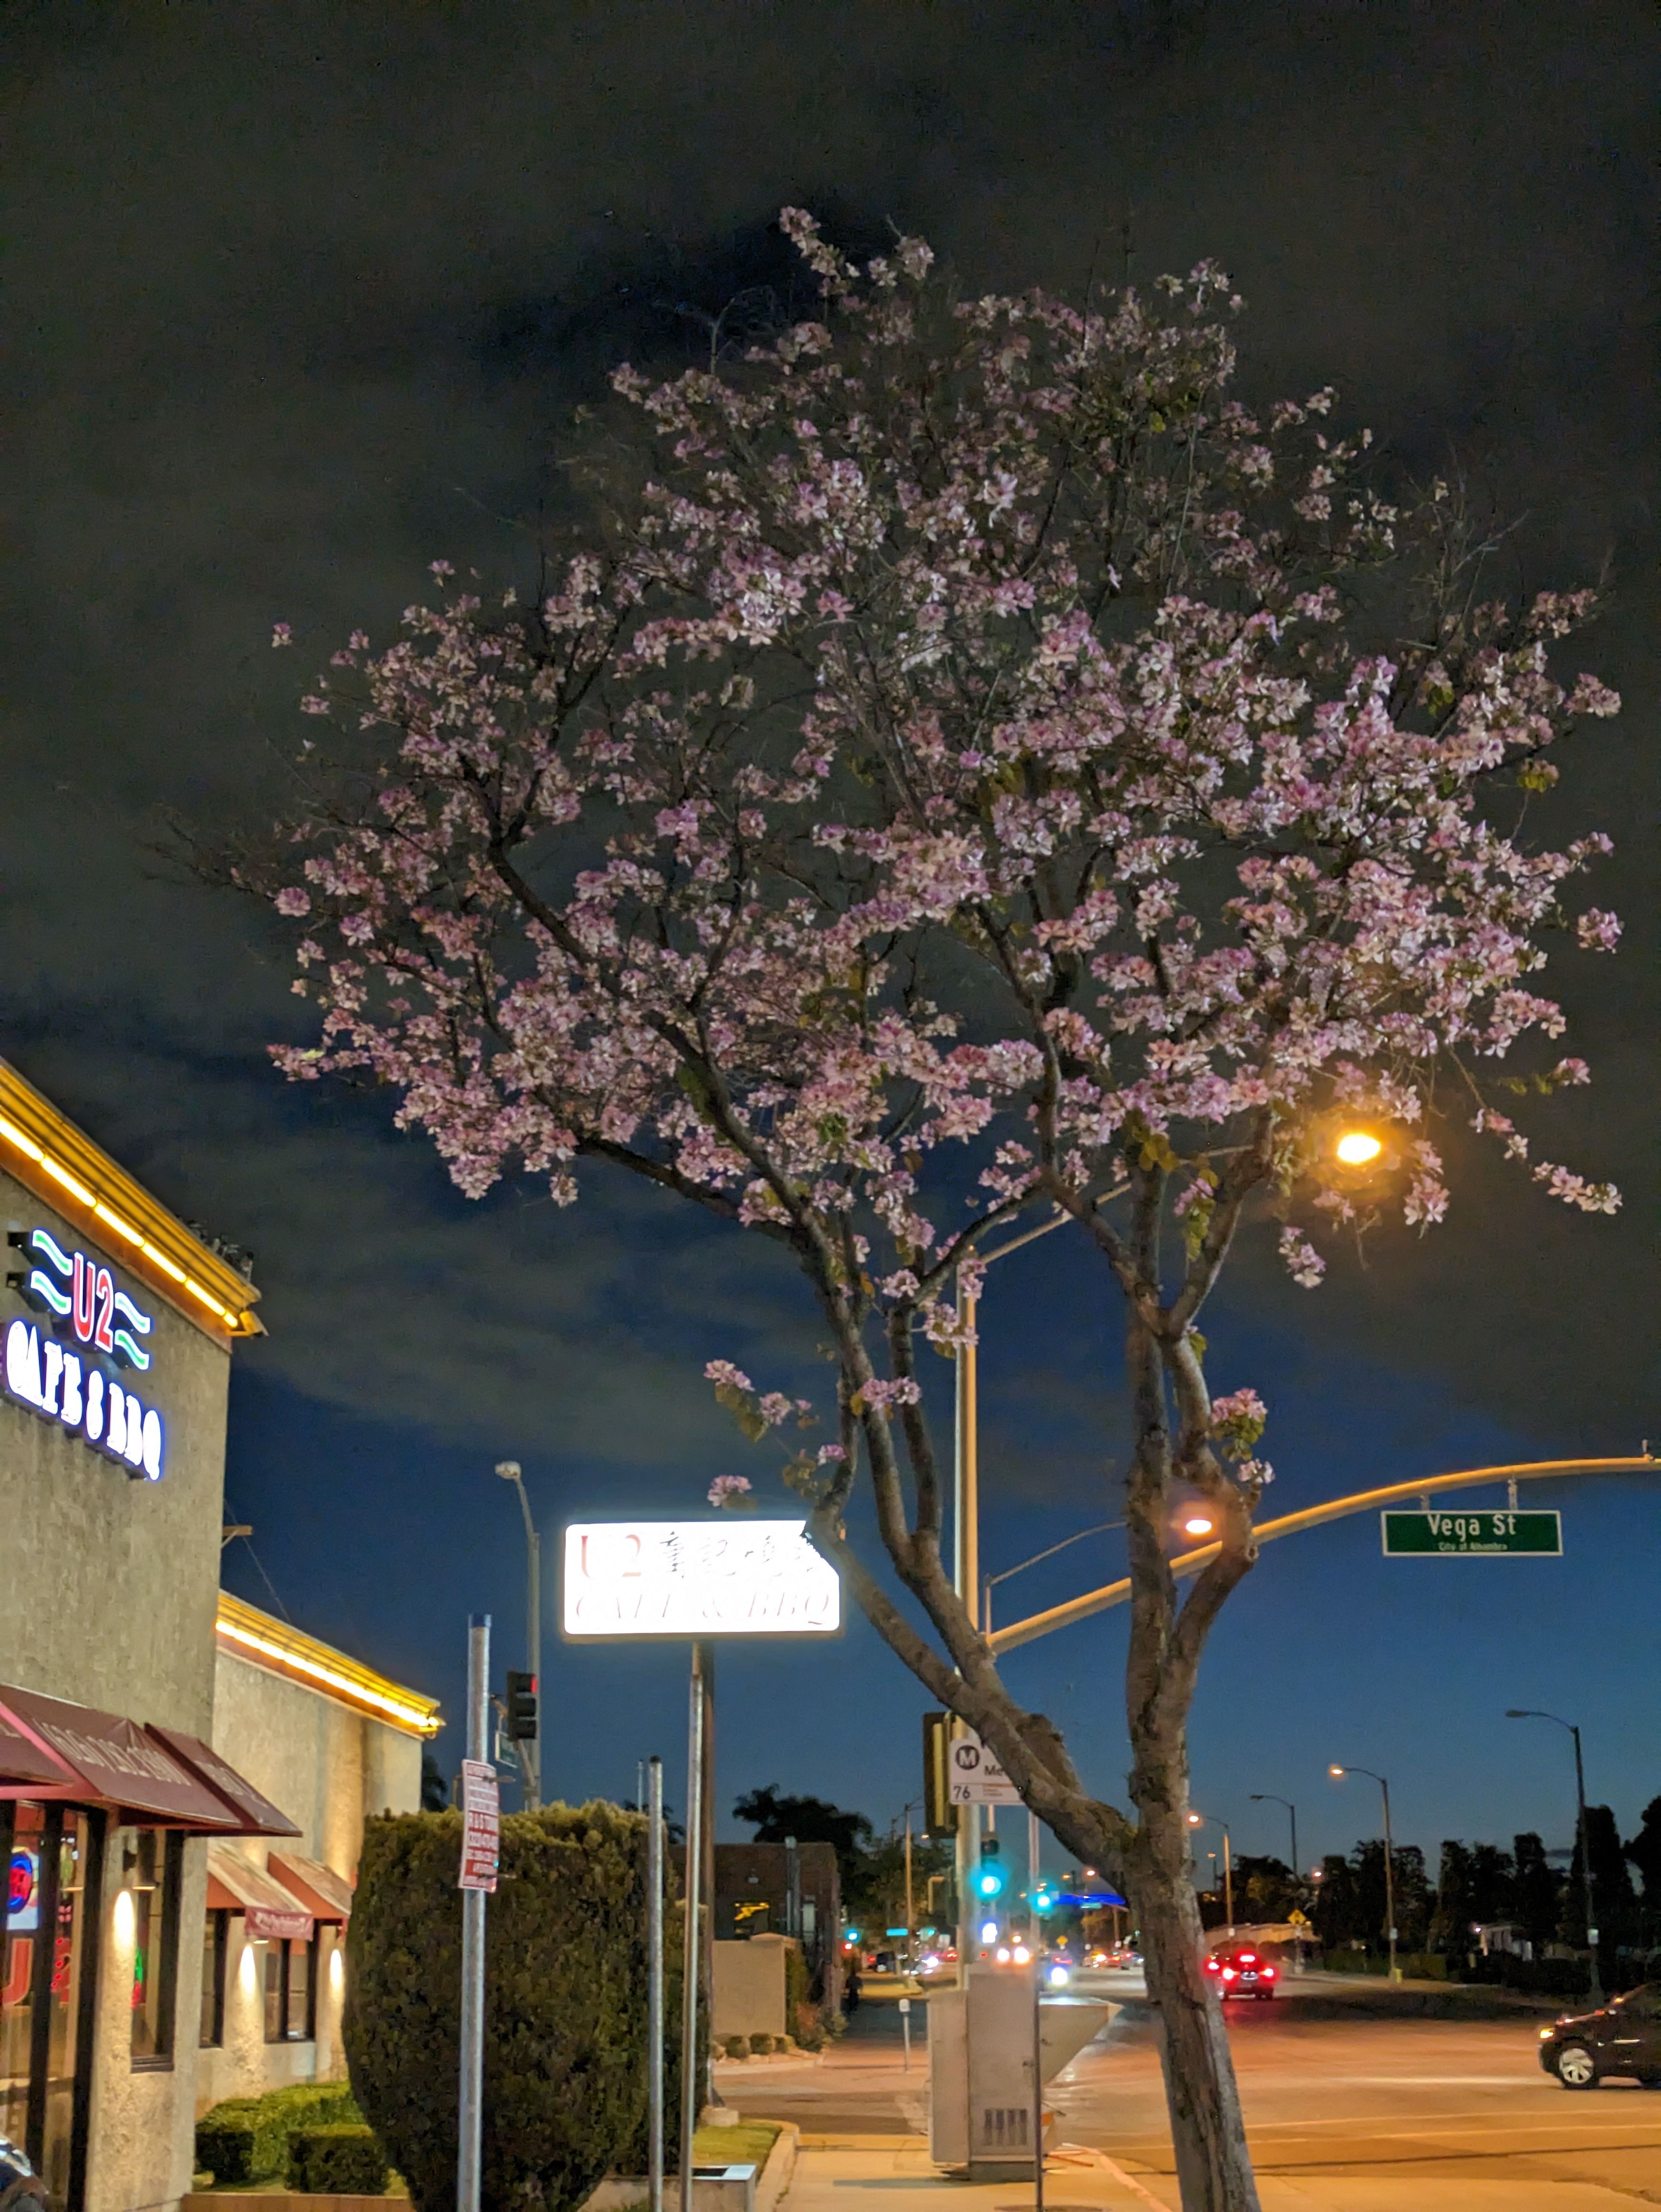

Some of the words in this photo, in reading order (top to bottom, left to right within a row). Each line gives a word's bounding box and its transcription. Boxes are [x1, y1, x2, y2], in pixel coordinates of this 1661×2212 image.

[73, 1252, 114, 1353] U2
[1427, 1514, 1481, 1542] Vega
[1492, 1514, 1517, 1535] St
[953, 1785, 971, 1800] 76
